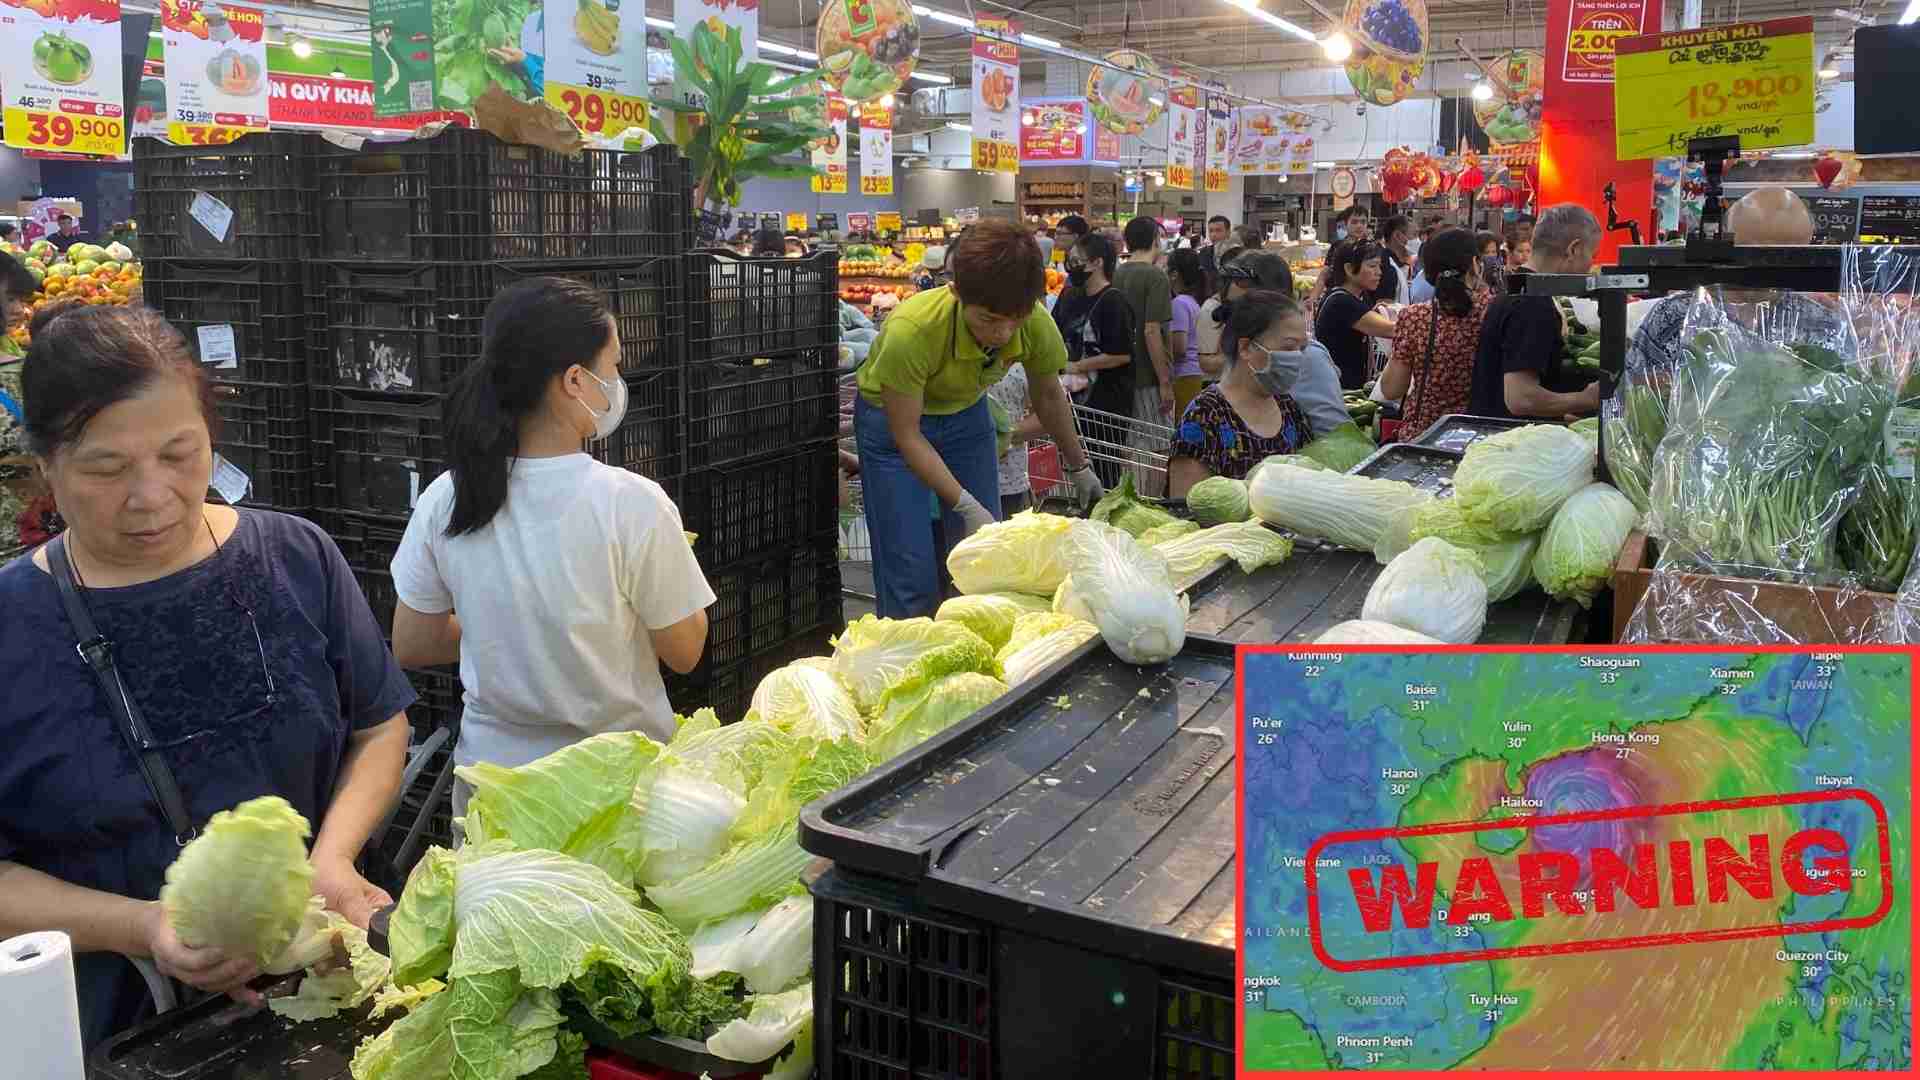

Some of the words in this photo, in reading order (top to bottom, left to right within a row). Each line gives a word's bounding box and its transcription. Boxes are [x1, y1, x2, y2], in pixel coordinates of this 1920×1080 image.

[1591, 18, 1622, 29] TRÊN
[291, 81, 332, 103] QUÝ
[562, 90, 645, 132] 29.900
[27, 112, 121, 146] 39.900
